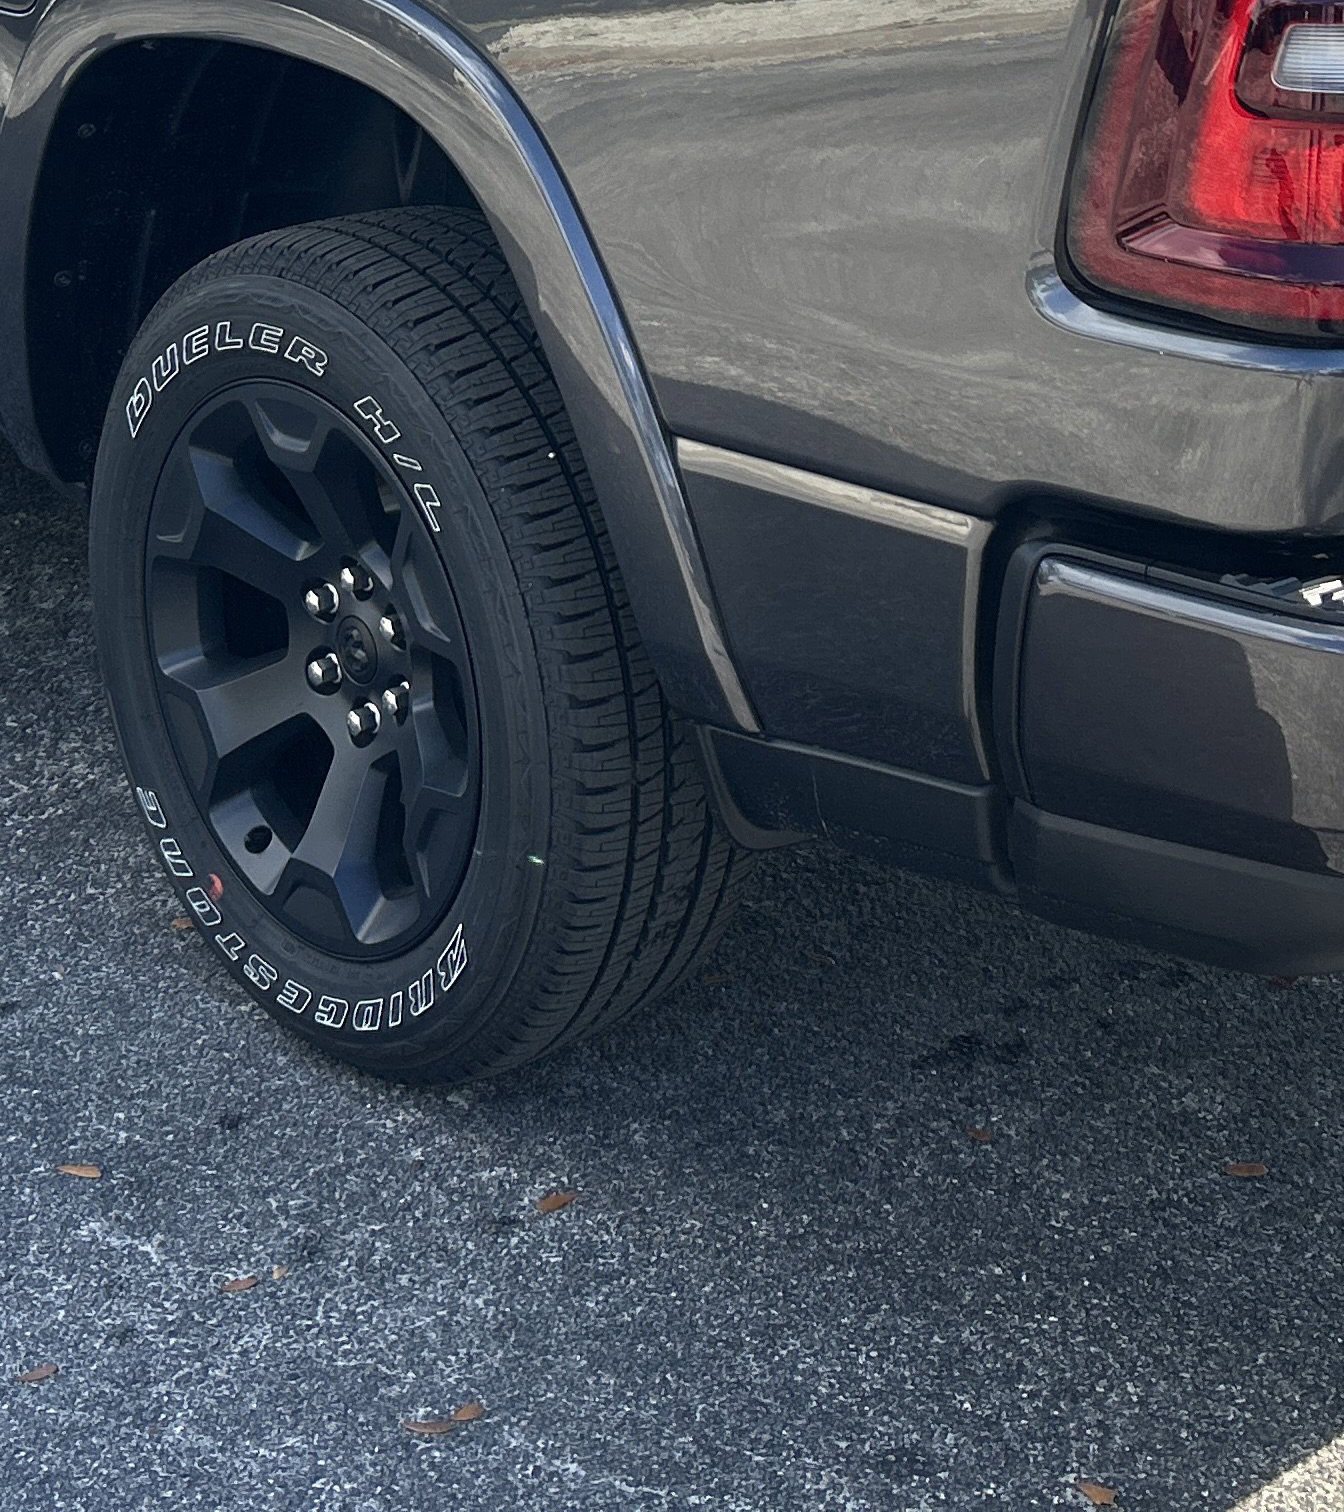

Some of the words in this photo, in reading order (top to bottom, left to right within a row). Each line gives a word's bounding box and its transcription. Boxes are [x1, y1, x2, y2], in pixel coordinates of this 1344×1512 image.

[126, 321, 328, 438] DUELER
[354, 396, 441, 532] H/L
[136, 787, 468, 1031] BRIDGESTONE
